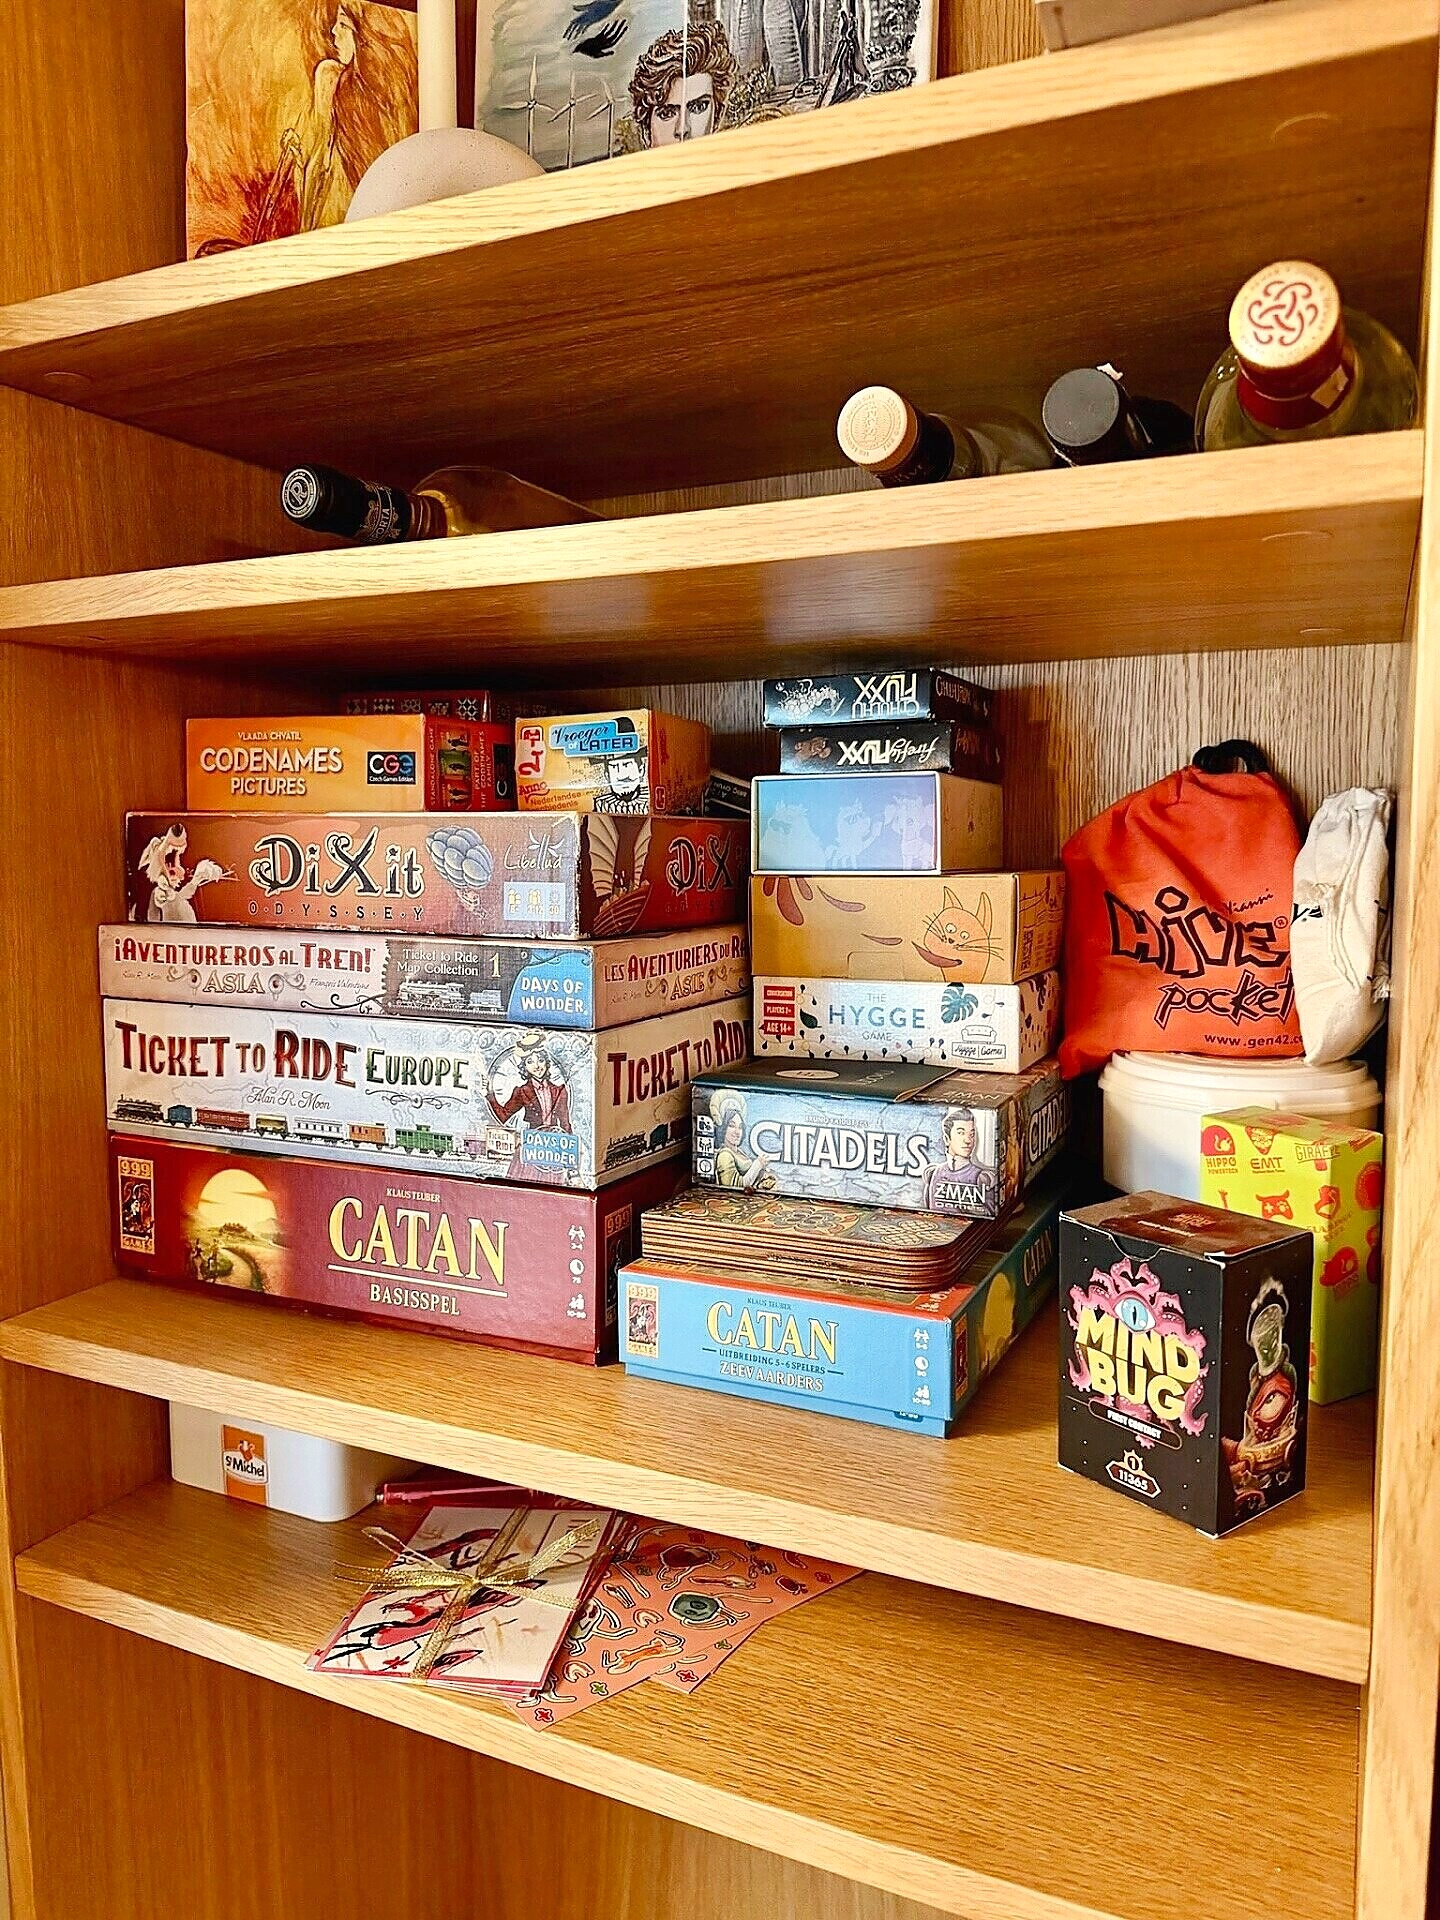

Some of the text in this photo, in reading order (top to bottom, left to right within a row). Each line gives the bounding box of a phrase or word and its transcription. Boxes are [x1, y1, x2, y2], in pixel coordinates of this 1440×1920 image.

[854, 673, 917, 703] FLUXX
[852, 699, 921, 719] CTHULHU
[238, 732, 268, 741] VLAADA
[551, 725, 609, 747] Vroeger
[579, 738, 633, 752] LATER
[200, 748, 343, 773] CODENAMES
[838, 740, 890, 766] FLUXX
[231, 777, 306, 796] PICTURES
[428, 754, 436, 805] STANDALONE
[529, 791, 582, 806] Nederlandse
[503, 833, 563, 870] Libellud
[279, 950, 299, 965] AL
[299, 942, 372, 973] TREN!
[397, 961, 479, 976] Map Collection
[402, 949, 479, 963] Ticket to Ride
[489, 953, 501, 978] 1
[604, 964, 625, 982] LES
[627, 942, 718, 981] AVENTURIERS
[719, 943, 730, 959] DU
[202, 969, 266, 995] ASIA
[520, 976, 583, 994] DAYS OF
[670, 971, 705, 1000] ASIE
[766, 1006, 785, 1014] PLAYERS
[867, 992, 888, 1003] THE
[1154, 967, 1294, 1031] pocket
[766, 1022, 792, 1033] AGE 14+
[828, 1004, 926, 1029] HYGGE
[862, 1030, 893, 1042] GAME
[114, 1020, 469, 1090] TICKET TO RIDE EUROPE
[607, 1039, 690, 1107] TICKET
[693, 1038, 712, 1073] TO
[246, 1086, 276, 1105] Alan
[297, 1098, 331, 1111] Moon
[526, 1133, 576, 1150] DAYS OF
[749, 1118, 932, 1178] CITADELS
[121, 1160, 151, 1177] 999
[525, 1148, 576, 1166] WONDER
[1205, 1156, 1237, 1168] HIPPO
[386, 1188, 441, 1203] KLAUS TEUBER
[607, 1211, 631, 1237] 999
[122, 1236, 154, 1250] GAMES
[327, 1196, 509, 1286] CATAN
[370, 1283, 460, 1316] BASISSPEL
[747, 1297, 792, 1311] KLAUS TEUBER
[706, 1300, 840, 1365] CATAN
[1076, 1304, 1200, 1384] MIND
[719, 1348, 826, 1375] UITBREIDING 5-6 SPELERS
[719, 1360, 824, 1393] ZEEVAARDERS
[1088, 1348, 1186, 1421] BUG
[232, 1456, 264, 1478] Michel
